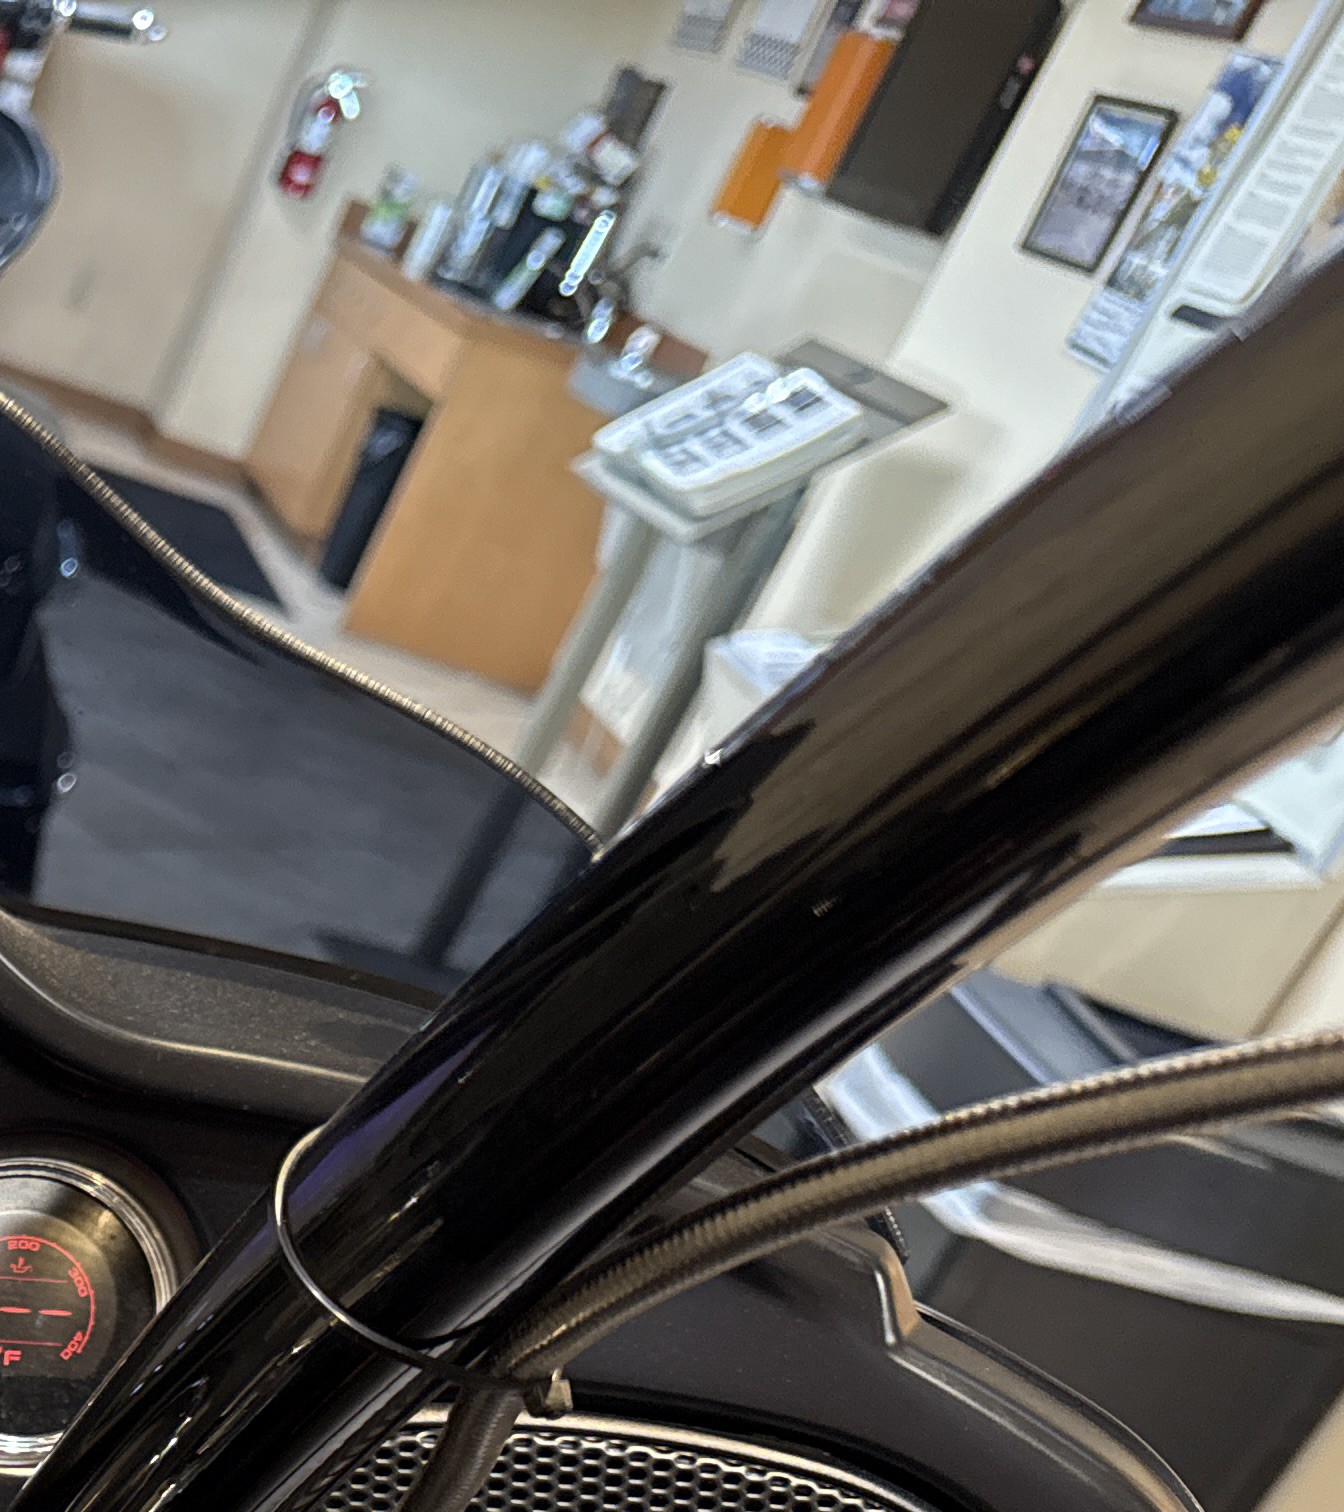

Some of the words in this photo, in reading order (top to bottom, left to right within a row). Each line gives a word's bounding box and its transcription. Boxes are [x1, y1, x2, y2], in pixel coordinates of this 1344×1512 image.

[6, 1240, 41, 1252] 200
[67, 1266, 89, 1299] 300
[59, 1330, 84, 1361] 400
